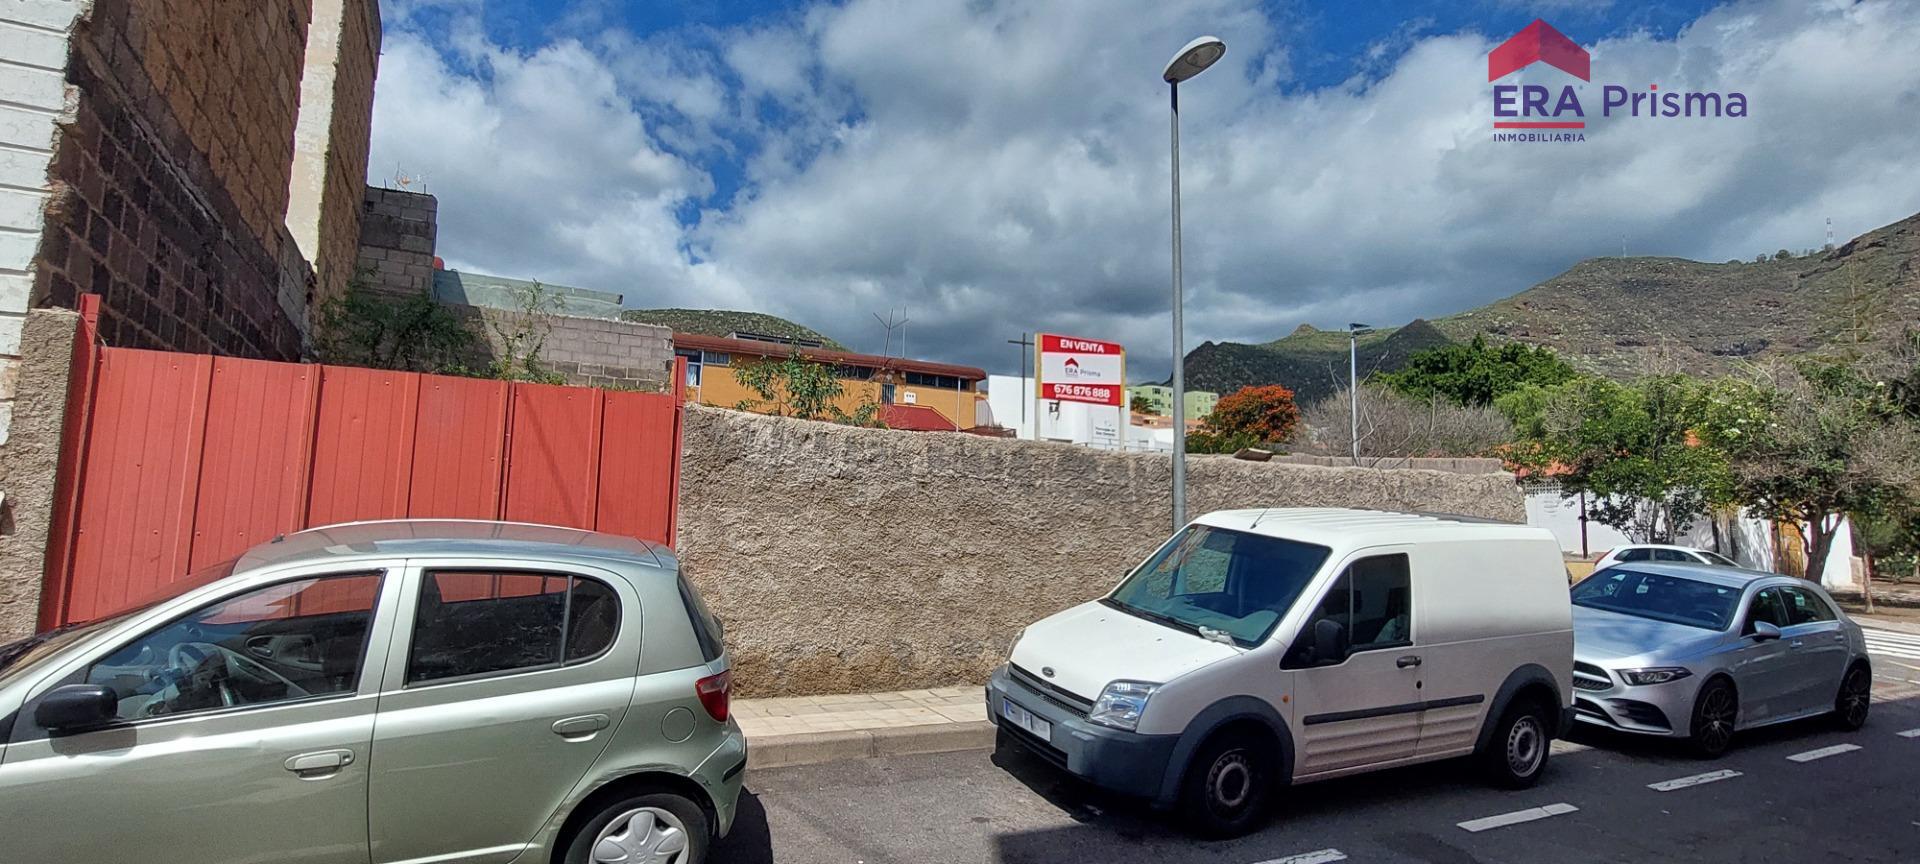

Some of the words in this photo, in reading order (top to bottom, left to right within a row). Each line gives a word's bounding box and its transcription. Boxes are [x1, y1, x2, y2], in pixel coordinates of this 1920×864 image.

[1060, 339, 1073, 349] EN
[1074, 341, 1105, 353] VENTA
[1054, 384, 1072, 395] 676
[1073, 386, 1091, 397] 876
[1092, 388, 1110, 398] 888
